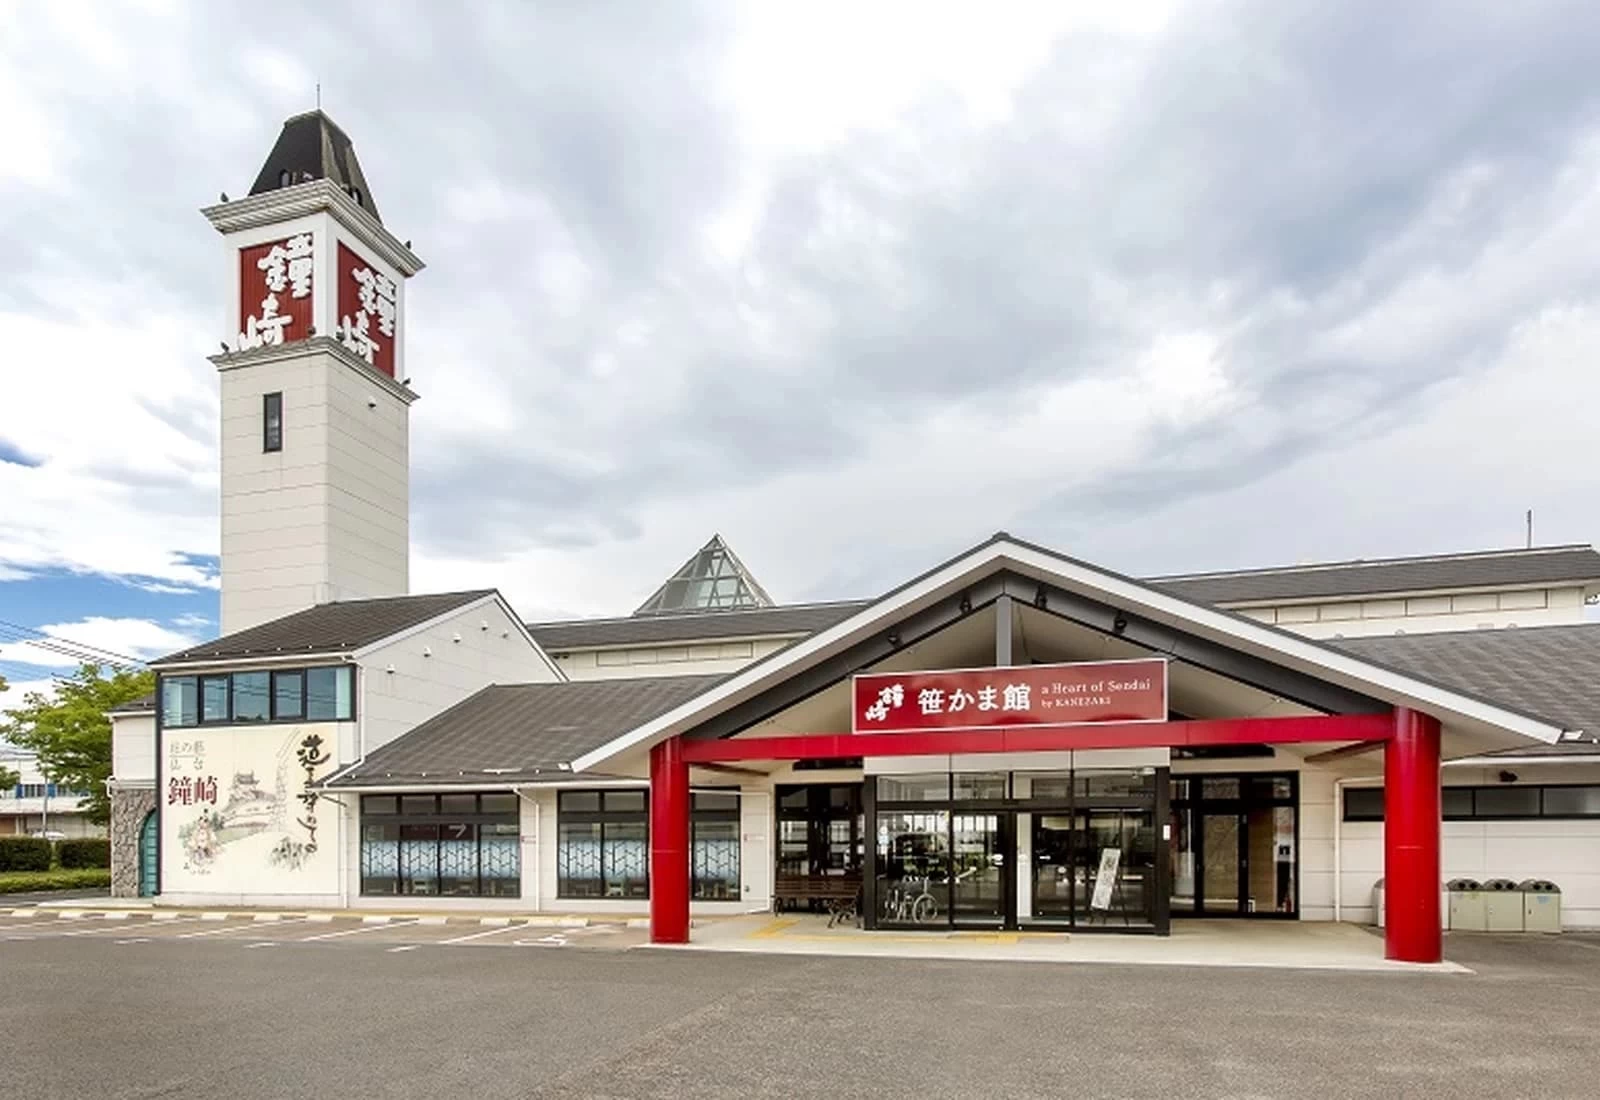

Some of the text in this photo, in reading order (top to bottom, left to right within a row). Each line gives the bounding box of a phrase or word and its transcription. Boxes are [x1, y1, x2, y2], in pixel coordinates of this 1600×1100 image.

[917, 683, 1032, 715] 笹かま館
[1041, 678, 1151, 694] a Heart of Sendai
[168, 775, 218, 805] 鐘崎
